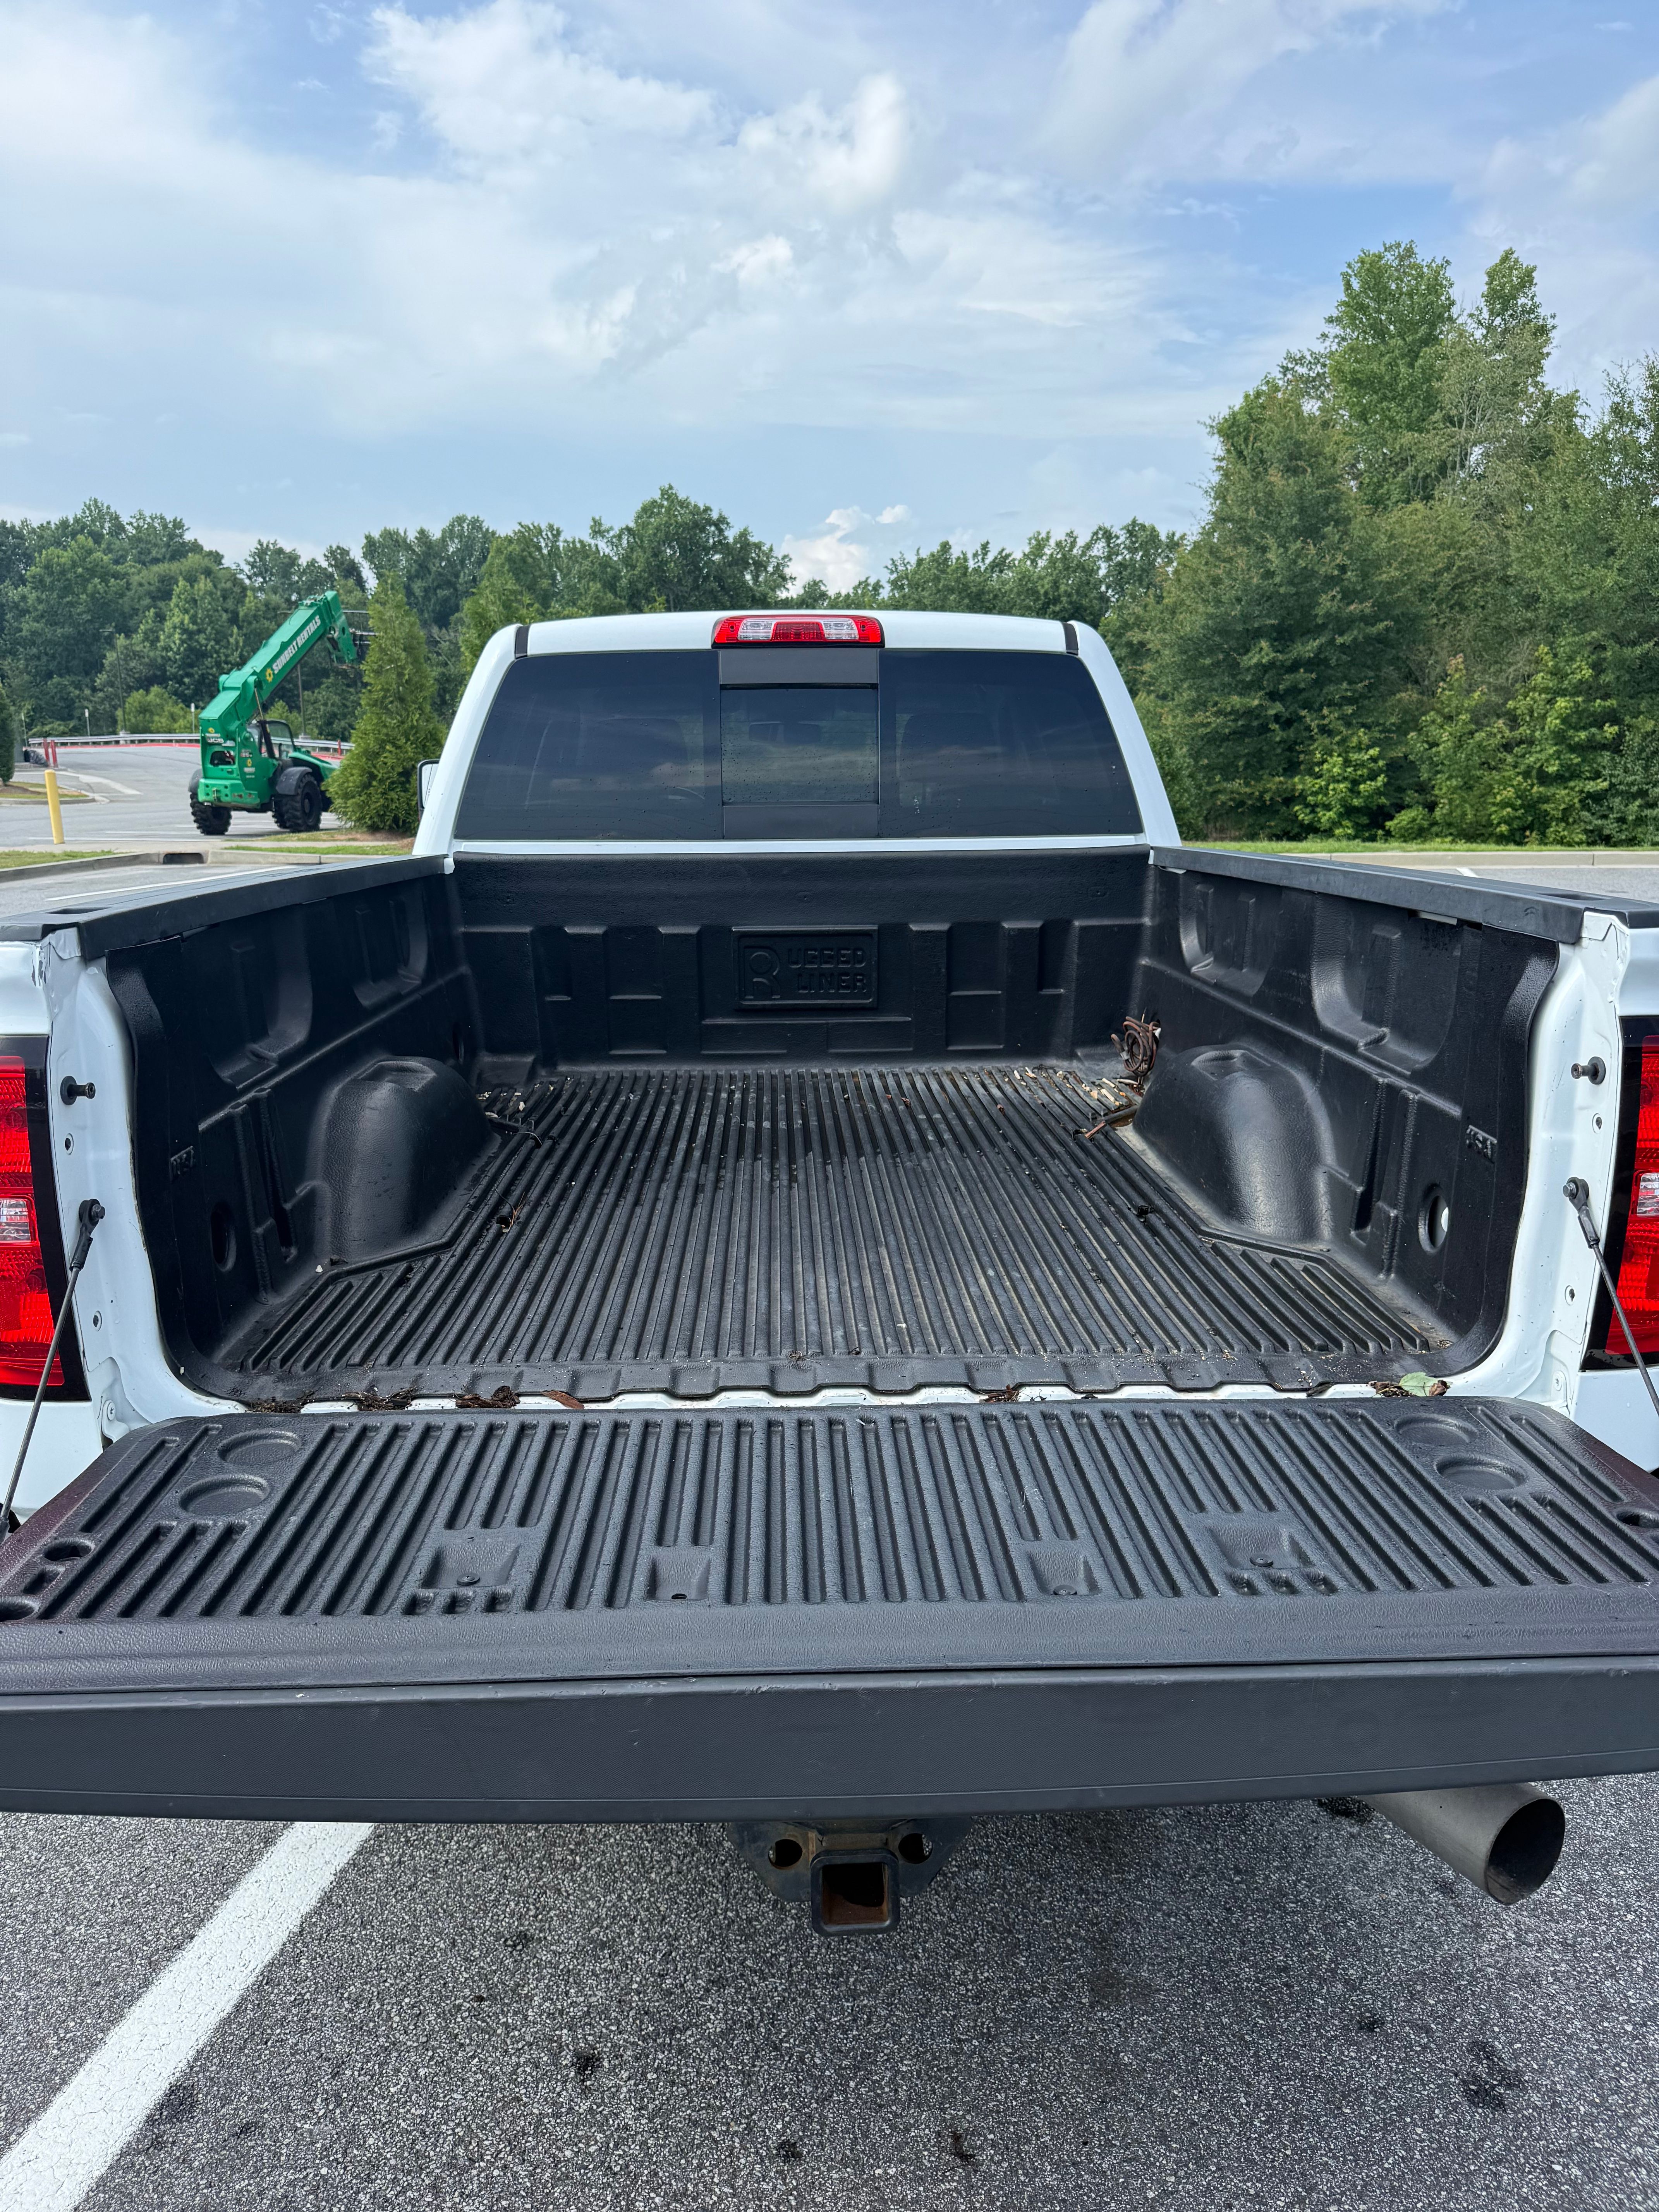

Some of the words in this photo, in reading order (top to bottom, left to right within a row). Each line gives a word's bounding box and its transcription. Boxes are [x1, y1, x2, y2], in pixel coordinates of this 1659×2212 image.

[272, 639, 298, 674] SUNBELT
[297, 615, 321, 648] RENTALS
[797, 973, 866, 993] LINER
